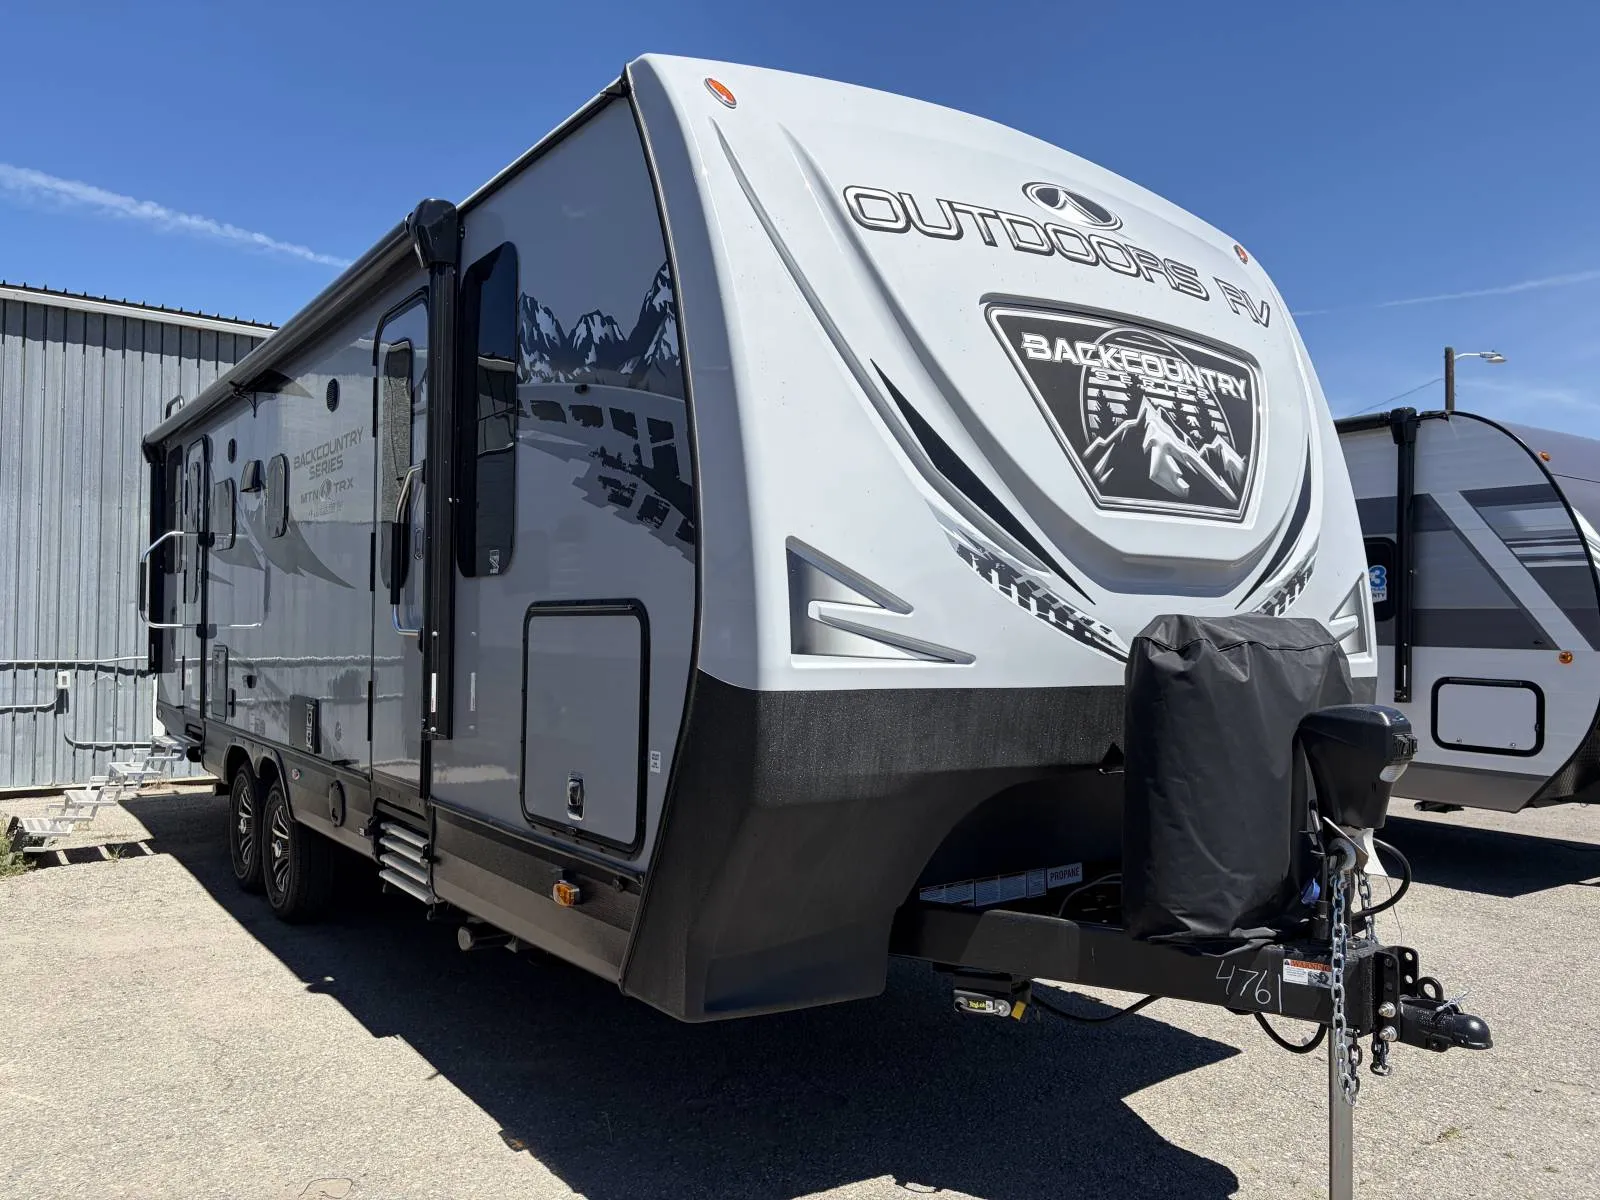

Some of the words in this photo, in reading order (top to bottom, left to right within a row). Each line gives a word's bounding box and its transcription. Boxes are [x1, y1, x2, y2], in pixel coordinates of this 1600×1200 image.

[843, 184, 1210, 301] OUTDOORS
[1213, 276, 1271, 328] RV
[1021, 331, 1248, 400] BACKCOUNTRY
[1094, 368, 1209, 400] SERIES
[293, 426, 364, 470] BACKCOUNTRY
[308, 455, 344, 480] SERIES
[1050, 866, 1081, 882] PROPANE
[1291, 960, 1333, 972] WARNING
[1216, 960, 1282, 1014] 4761
